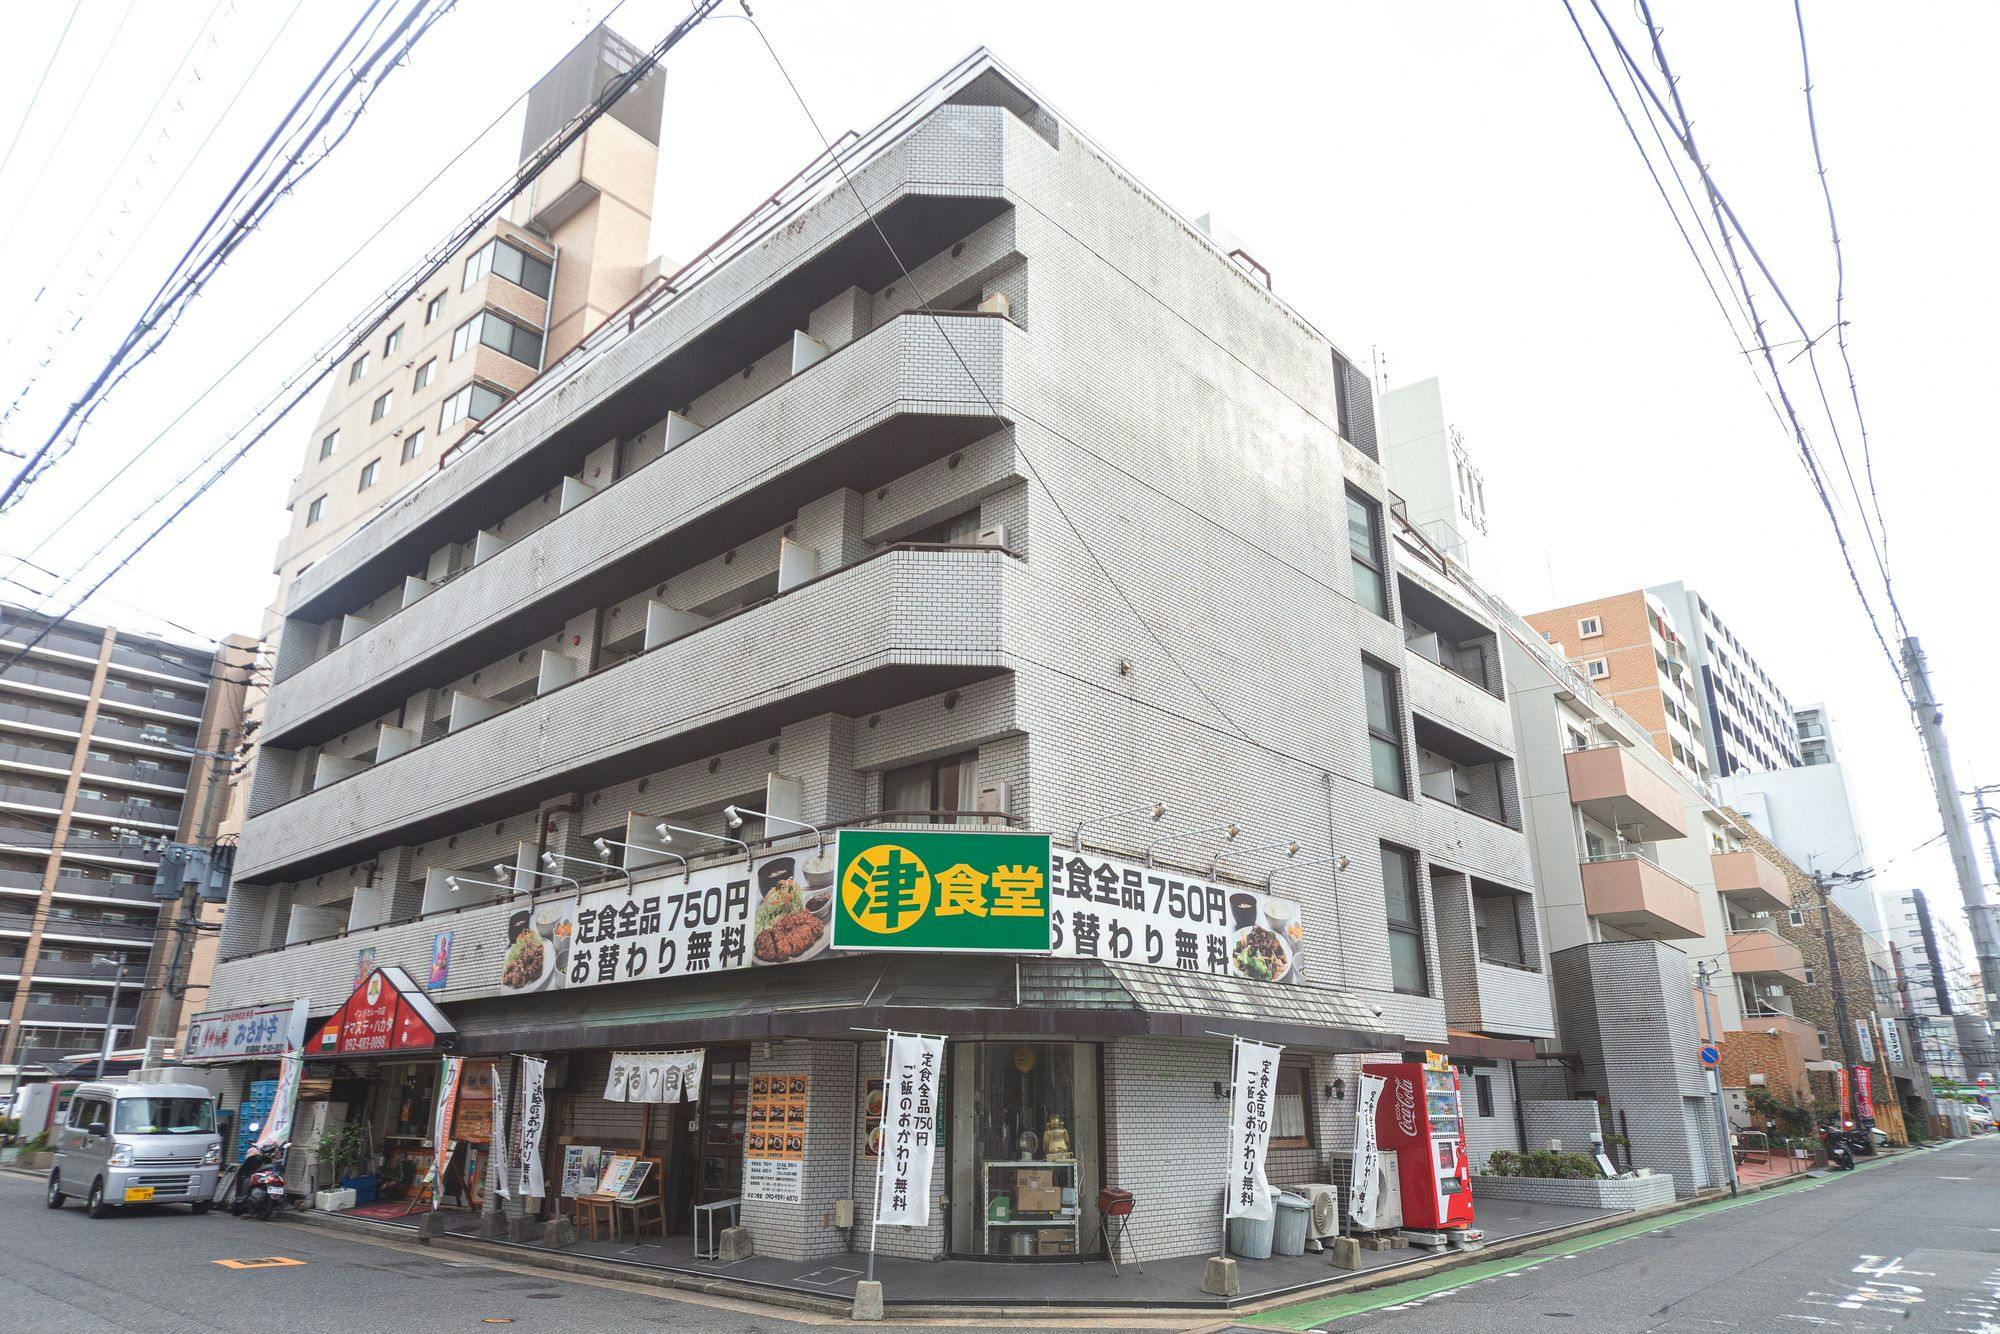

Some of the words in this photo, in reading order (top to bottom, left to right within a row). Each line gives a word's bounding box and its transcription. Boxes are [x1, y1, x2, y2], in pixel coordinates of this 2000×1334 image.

[575, 879, 751, 946] 定食全品750円
[571, 924, 746, 984] お替わり無料
[343, 1017, 393, 1037] ナマステ・ハカタ
[614, 1063, 695, 1091] まるつ食堂
[914, 1052, 934, 1147] 定食全品750円
[1257, 1060, 1272, 1147] 定食全品50
[892, 1064, 916, 1212] ご飯のおかわり無料
[1240, 1071, 1258, 1208] ご飯のおかわり無料
